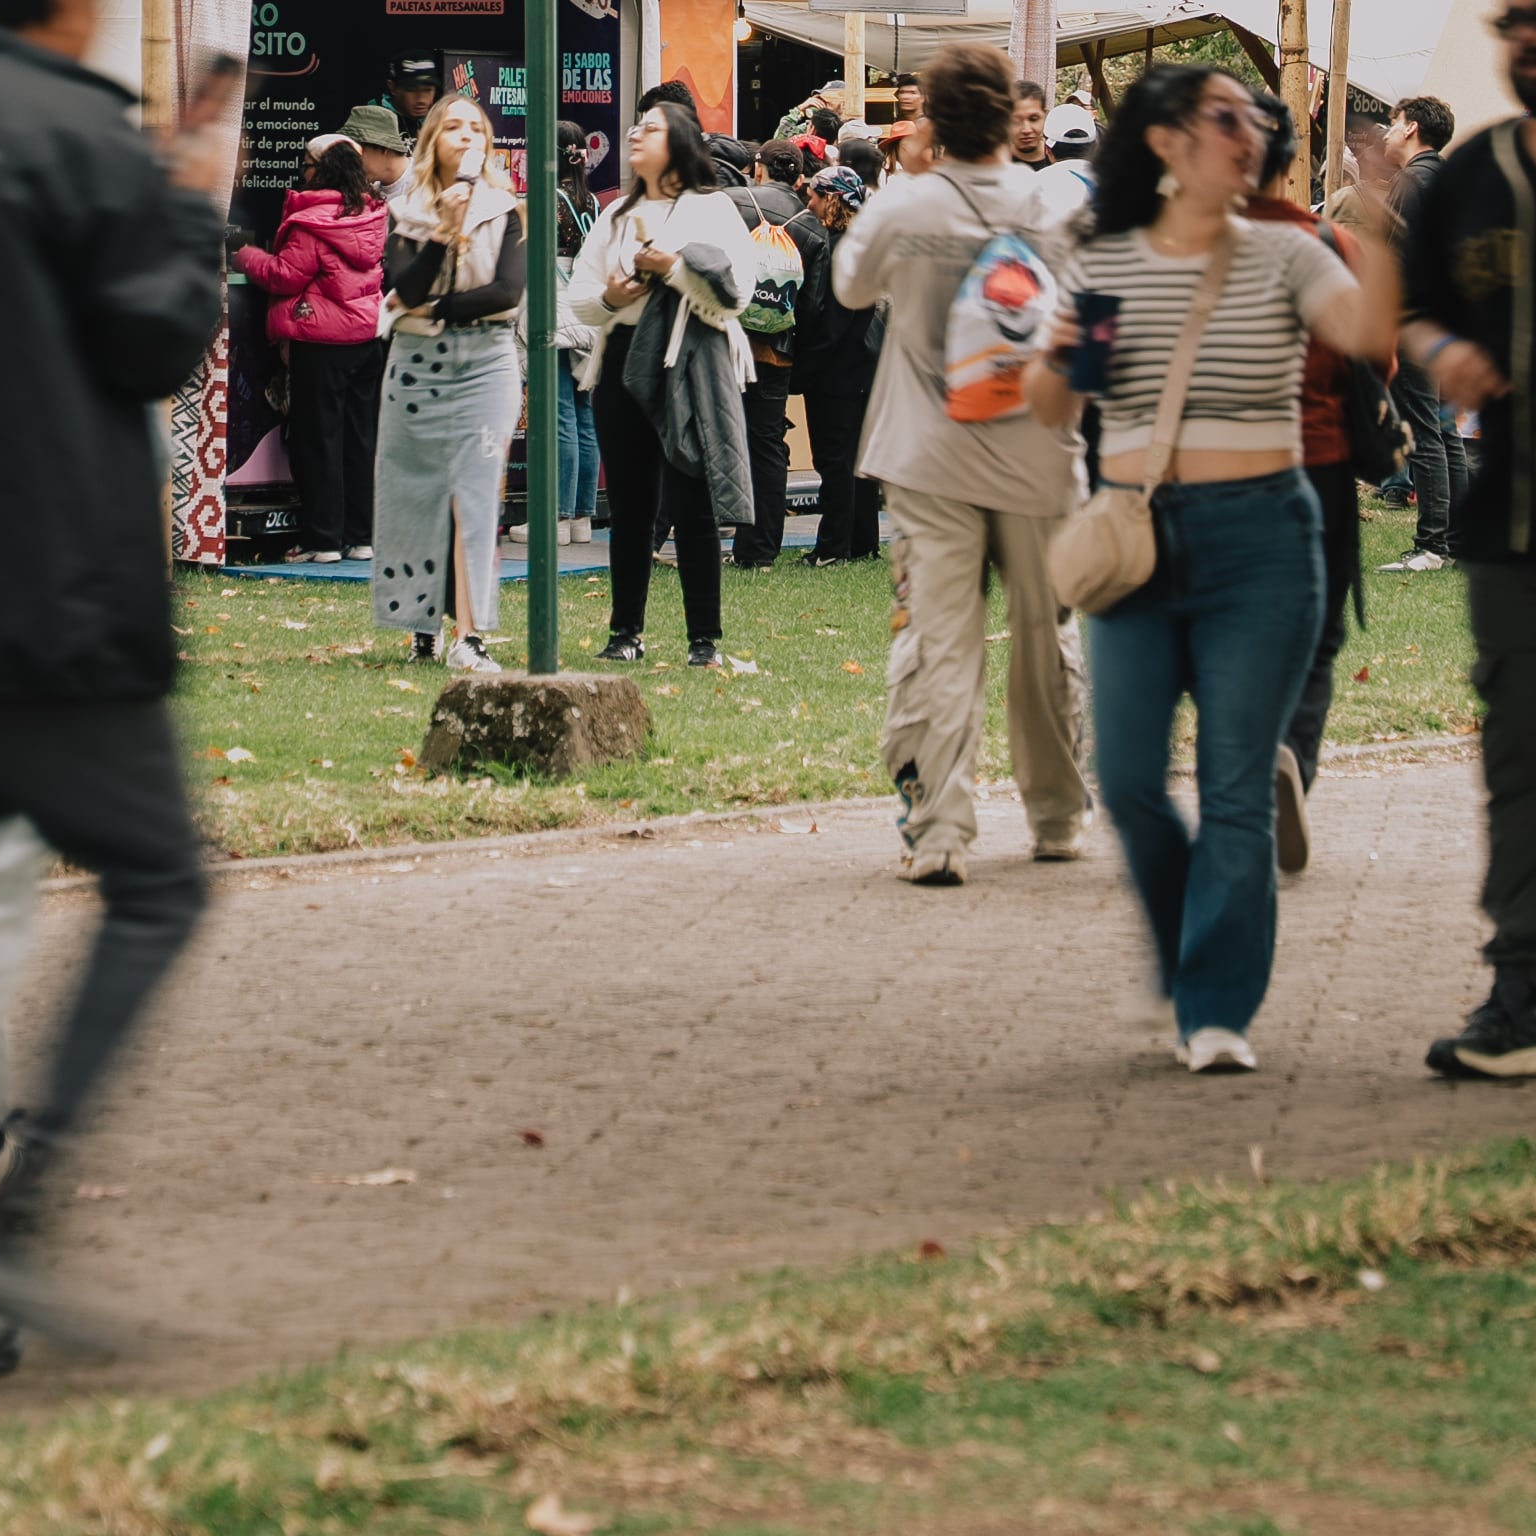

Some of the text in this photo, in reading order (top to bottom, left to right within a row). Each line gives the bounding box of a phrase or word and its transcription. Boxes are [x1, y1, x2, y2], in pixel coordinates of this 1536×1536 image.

[390, 1, 502, 12] PALETAS ARTESANALES
[574, 52, 611, 69] SABOR
[562, 69, 613, 91] DE LAS
[259, 97, 270, 111] el
[273, 97, 315, 111] mundo
[562, 91, 613, 104] EMOCIONES
[256, 117, 320, 131] emociones
[257, 136, 273, 150] de
[242, 157, 299, 169] artesanal
